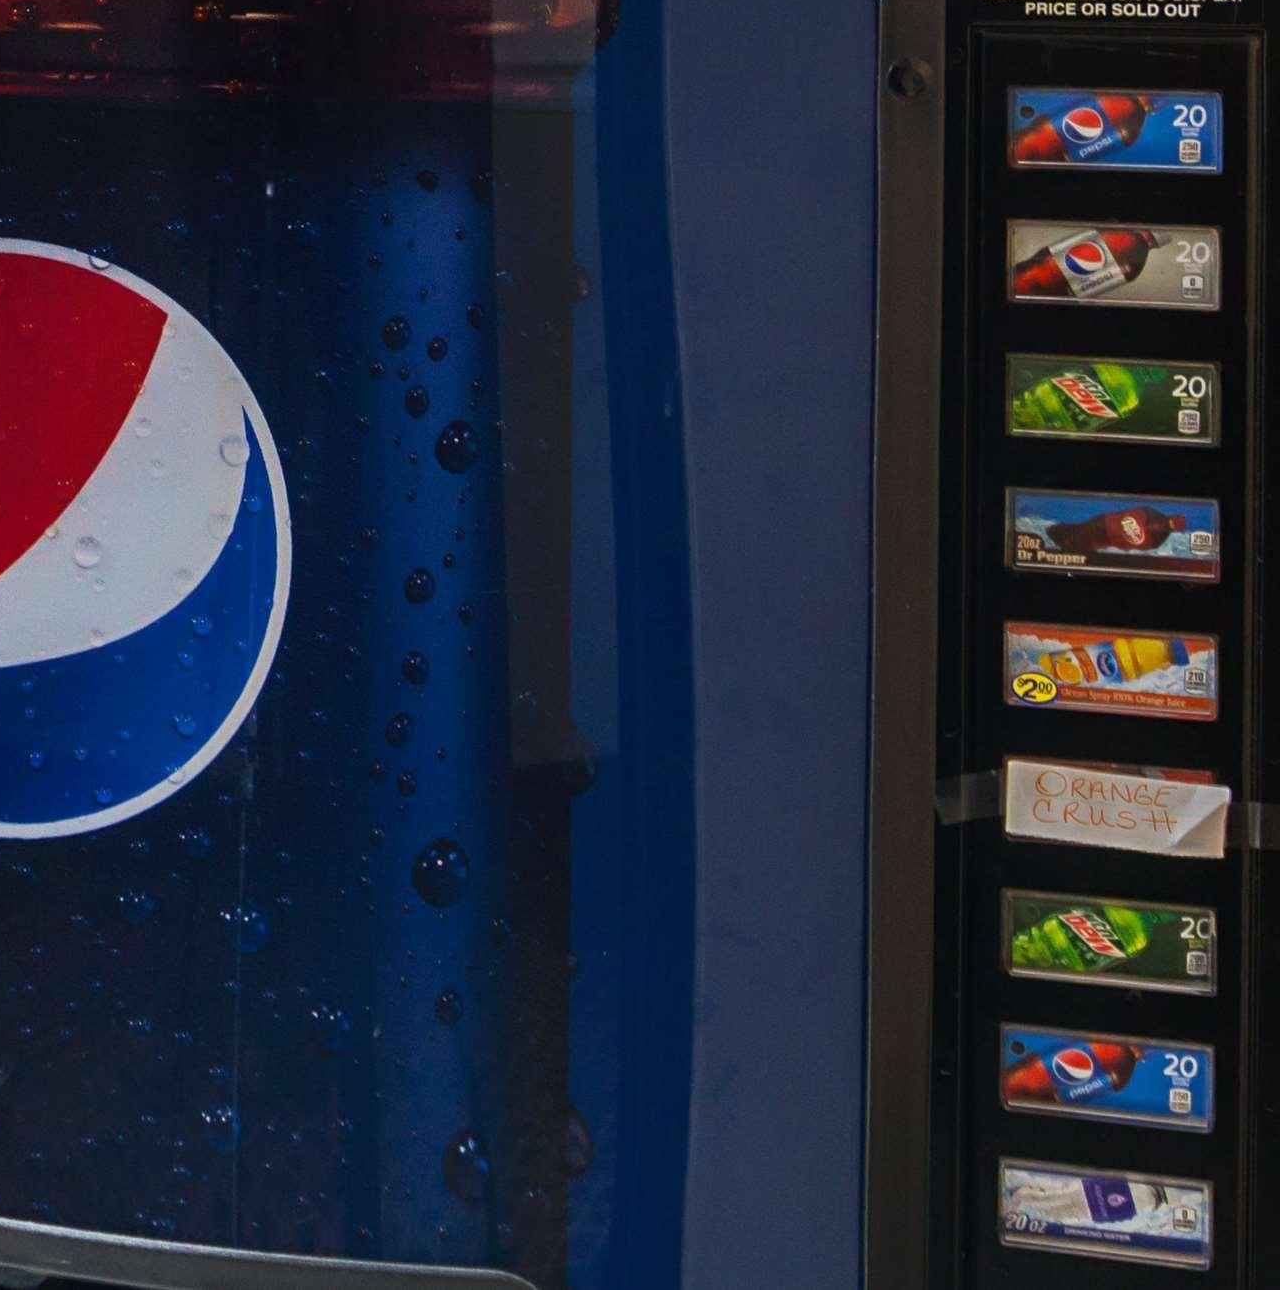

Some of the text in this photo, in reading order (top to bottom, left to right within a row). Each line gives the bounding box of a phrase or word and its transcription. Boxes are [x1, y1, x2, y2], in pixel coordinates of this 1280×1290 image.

[1025, 2, 1201, 18] PRICE OR SOLD OUT
[1079, 104, 1207, 158] pepsi 20
[1176, 241, 1210, 264] 20
[1172, 374, 1206, 398] 20
[1017, 549, 1087, 565] Dr Pepper
[1090, 690, 1111, 701] Spray
[1035, 770, 1178, 808] ORANGE
[1033, 799, 1178, 833] CRUSH
[1163, 1053, 1198, 1078] 20
[1005, 1213, 1027, 1231] 20
